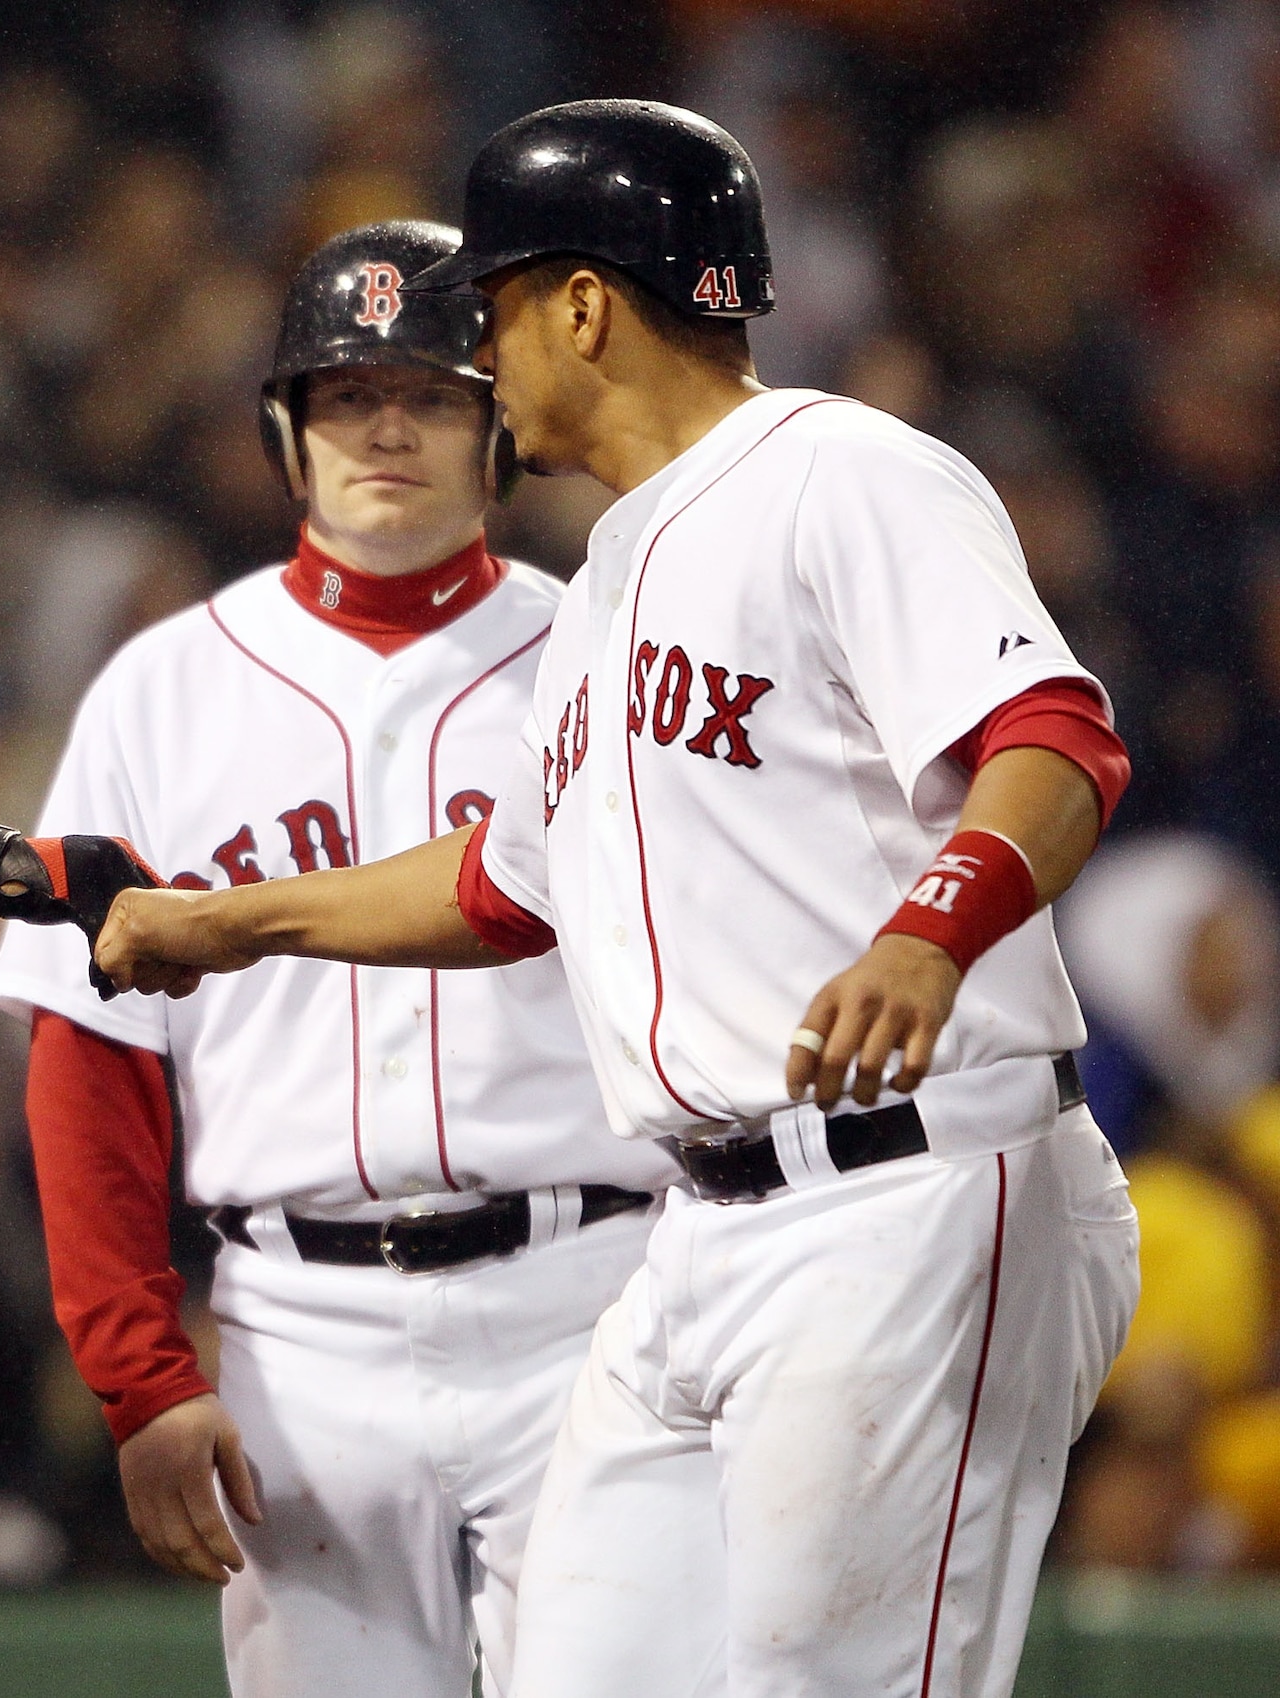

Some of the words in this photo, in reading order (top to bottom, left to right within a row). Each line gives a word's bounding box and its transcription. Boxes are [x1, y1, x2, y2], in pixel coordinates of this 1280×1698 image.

[356, 263, 405, 327] B
[693, 265, 741, 309] 41
[319, 571, 342, 609] B
[627, 639, 775, 769] SOX
[908, 875, 963, 914] 41
